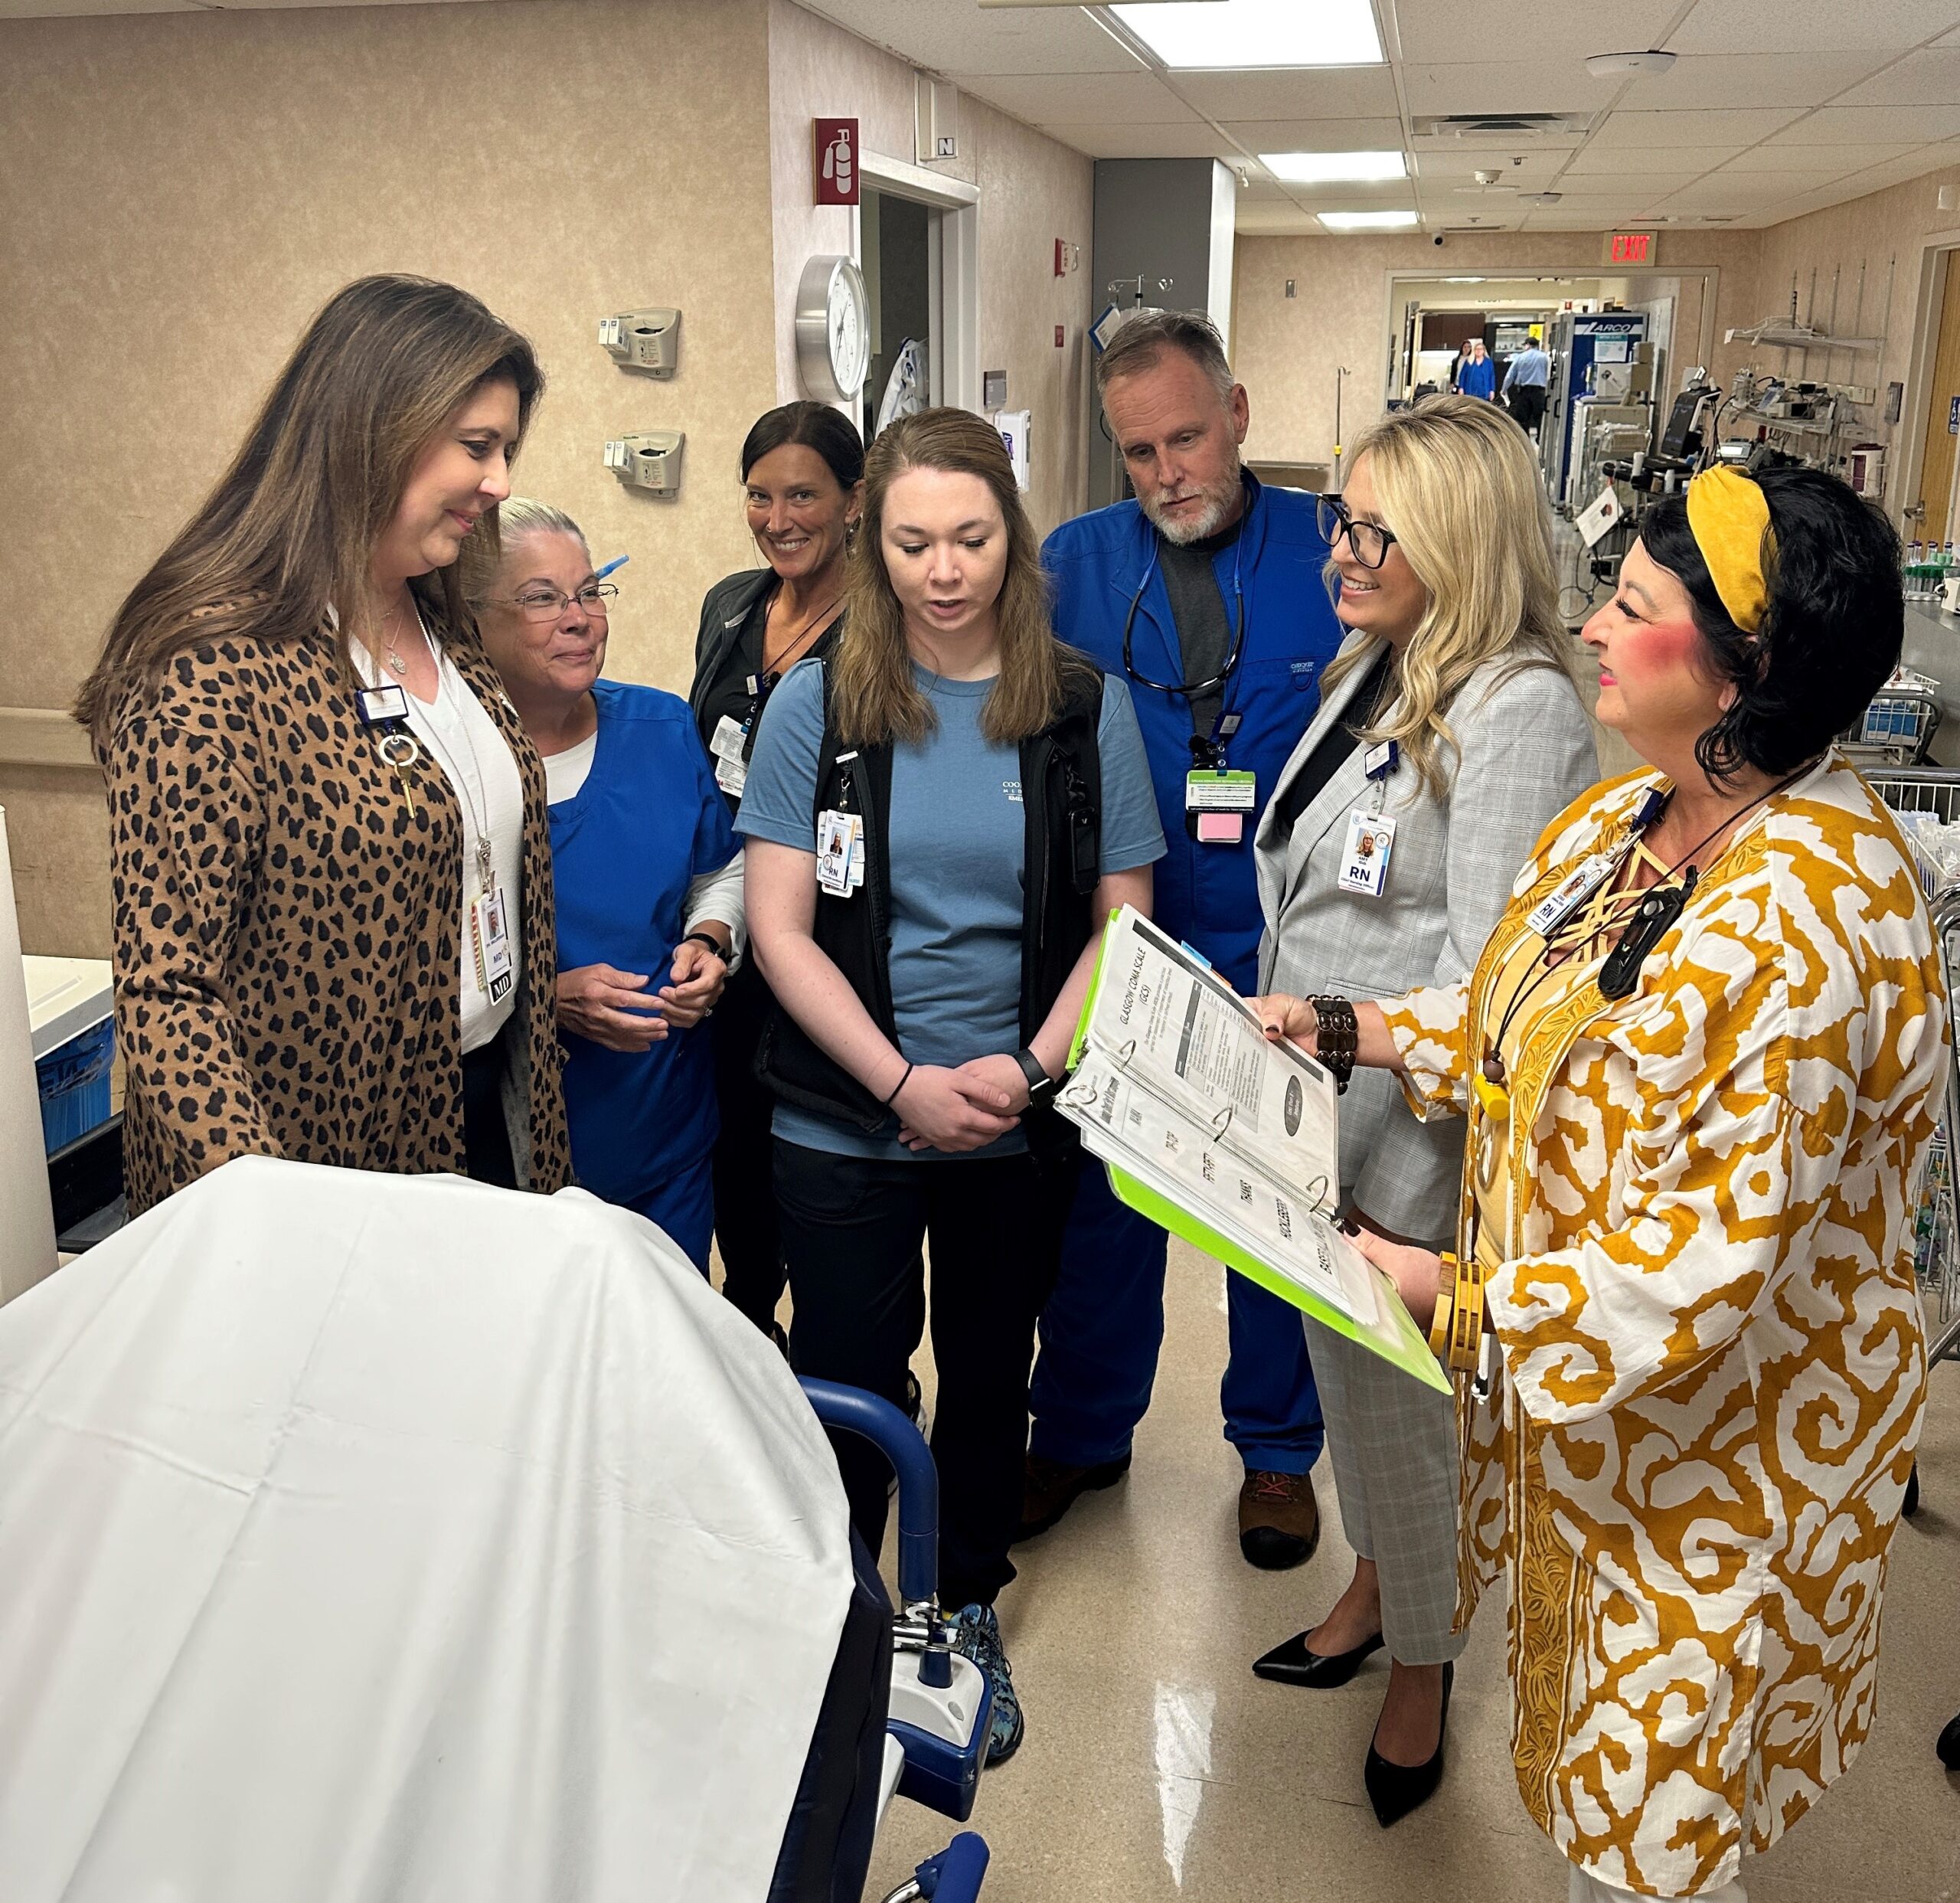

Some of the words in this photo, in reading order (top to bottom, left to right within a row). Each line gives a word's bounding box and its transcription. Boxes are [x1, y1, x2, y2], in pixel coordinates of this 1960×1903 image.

[939, 138, 954, 155] N
[1612, 235, 1651, 262] EXIT
[829, 867, 838, 878] RN
[1350, 866, 1370, 882] RN
[1540, 904, 1557, 919] RN
[493, 952, 502, 964] MD
[1133, 946, 1145, 970] SCALE
[494, 976, 509, 999] MD
[1128, 967, 1140, 991] COMA
[1119, 987, 1135, 1025] GLASGOW
[1138, 982, 1151, 1006] (GCS)
[1203, 1152, 1215, 1184] FIFTY-FIFTY
[1240, 1179, 1253, 1206] THANKS
[1276, 1196, 1292, 1242] HUCKLEBERRY
[1315, 1236, 1332, 1276] BASEBALL
